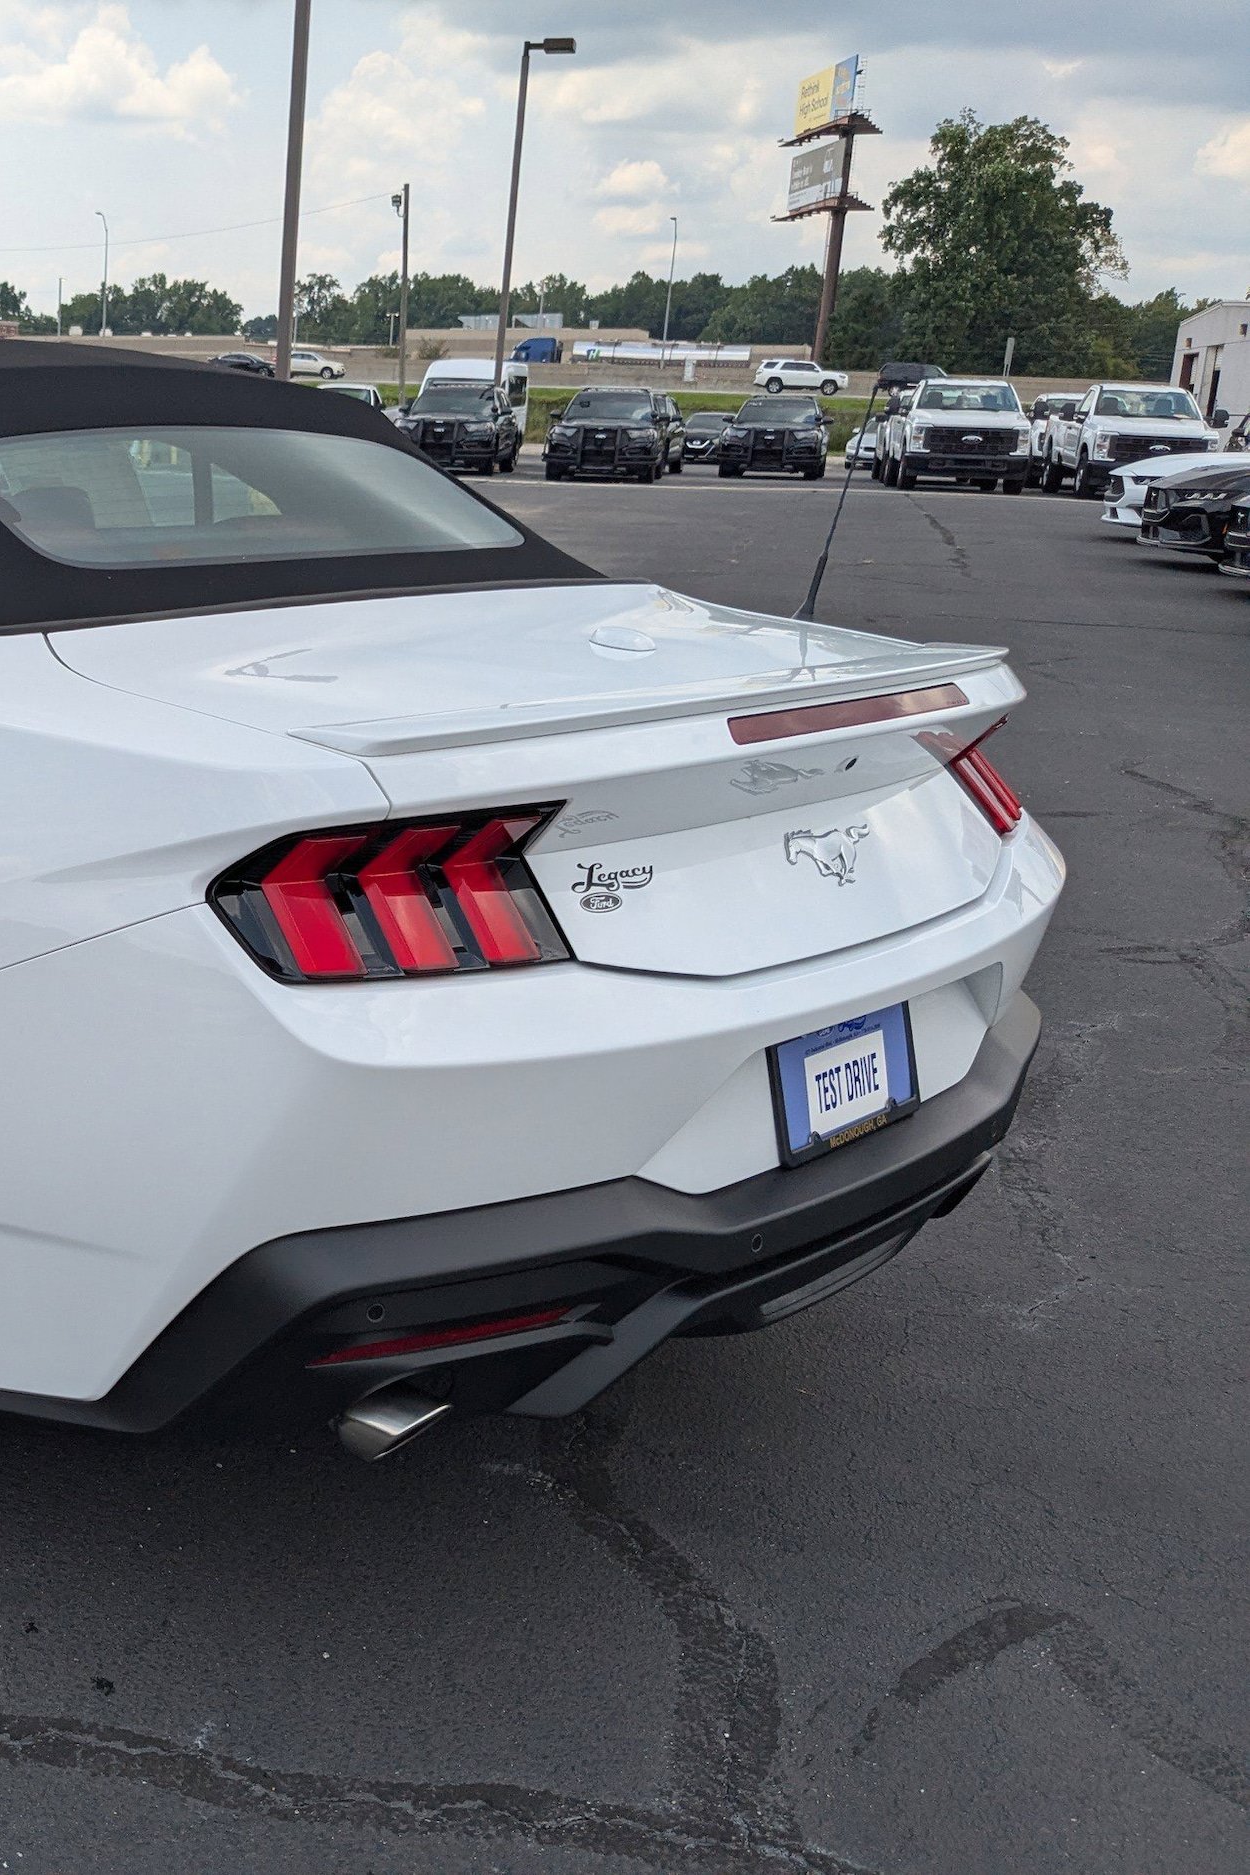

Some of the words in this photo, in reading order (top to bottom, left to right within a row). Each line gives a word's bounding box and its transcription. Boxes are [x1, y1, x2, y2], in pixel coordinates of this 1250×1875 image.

[801, 79, 819, 98] Rethink
[799, 99, 811, 119] High
[811, 93, 829, 112] School
[571, 862, 653, 893] Legacy
[589, 896, 614, 910] Ford
[815, 1066, 842, 1114] TEST
[845, 1052, 879, 1101] DRIVE
[876, 1113, 888, 1127] GA
